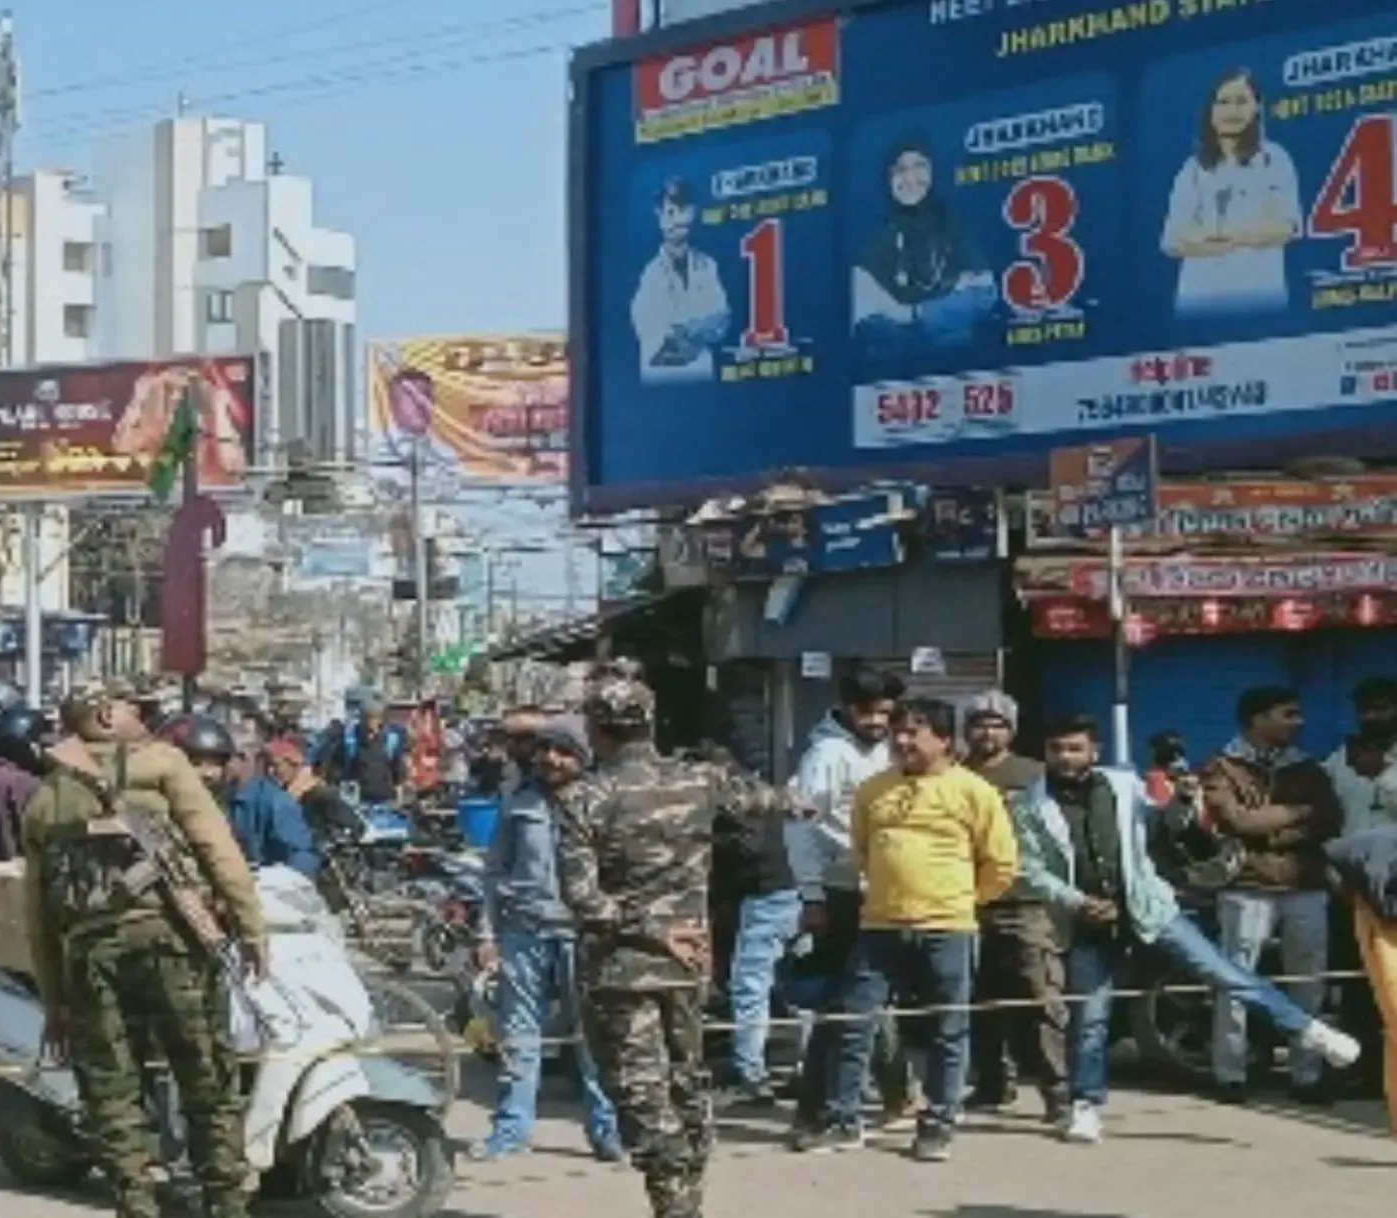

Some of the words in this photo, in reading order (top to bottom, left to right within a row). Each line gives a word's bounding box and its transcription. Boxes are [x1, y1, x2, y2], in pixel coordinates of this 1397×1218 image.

[658, 31, 810, 101] GOAL
[995, 0, 1171, 58] JHARKHAND
[1002, 174, 1086, 312] 3
[1307, 112, 1397, 271] 4
[739, 217, 790, 350] 1
